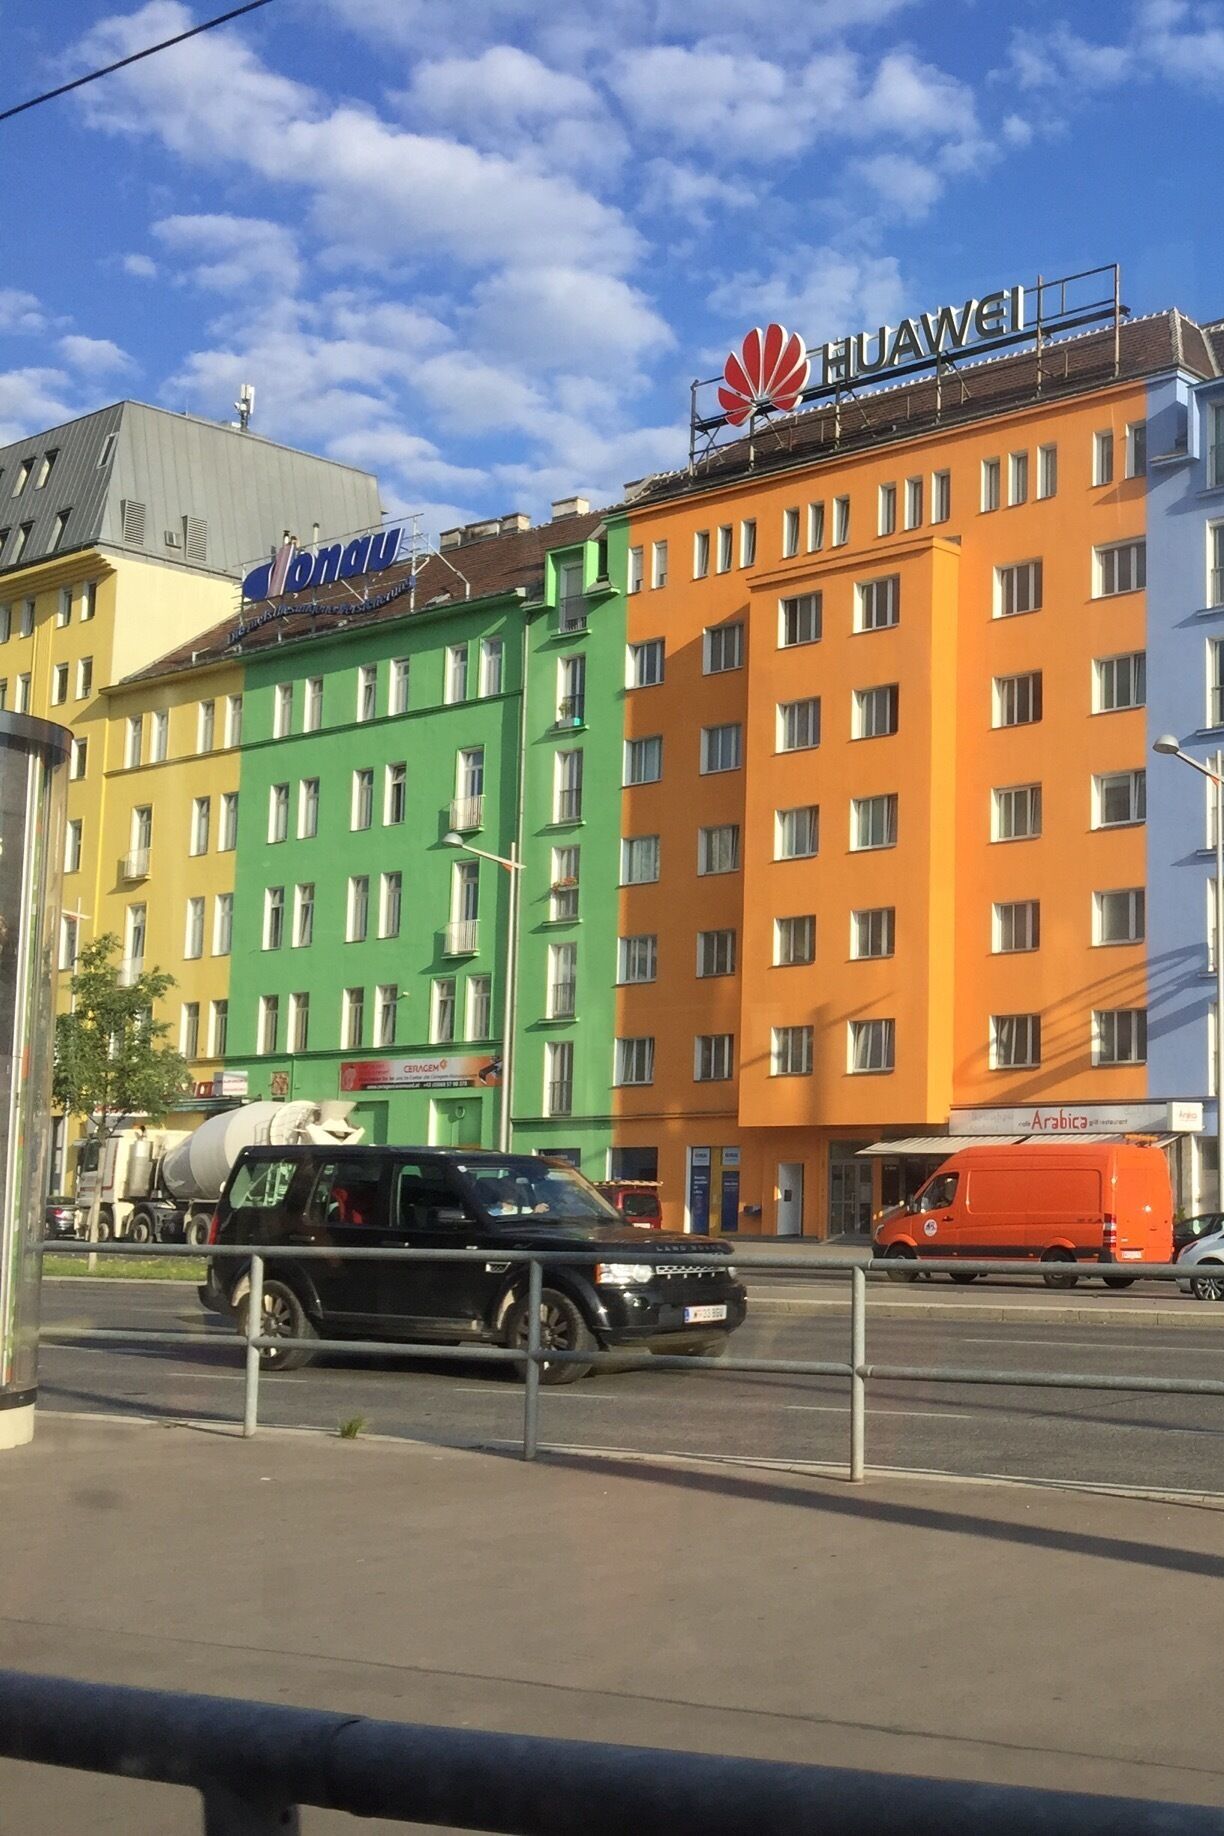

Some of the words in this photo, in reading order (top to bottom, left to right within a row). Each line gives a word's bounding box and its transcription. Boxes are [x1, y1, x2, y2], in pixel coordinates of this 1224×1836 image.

[822, 285, 1024, 384] HUAWEI
[404, 1064, 440, 1073] CERAGEM
[1031, 1109, 1088, 1130] Arabica
